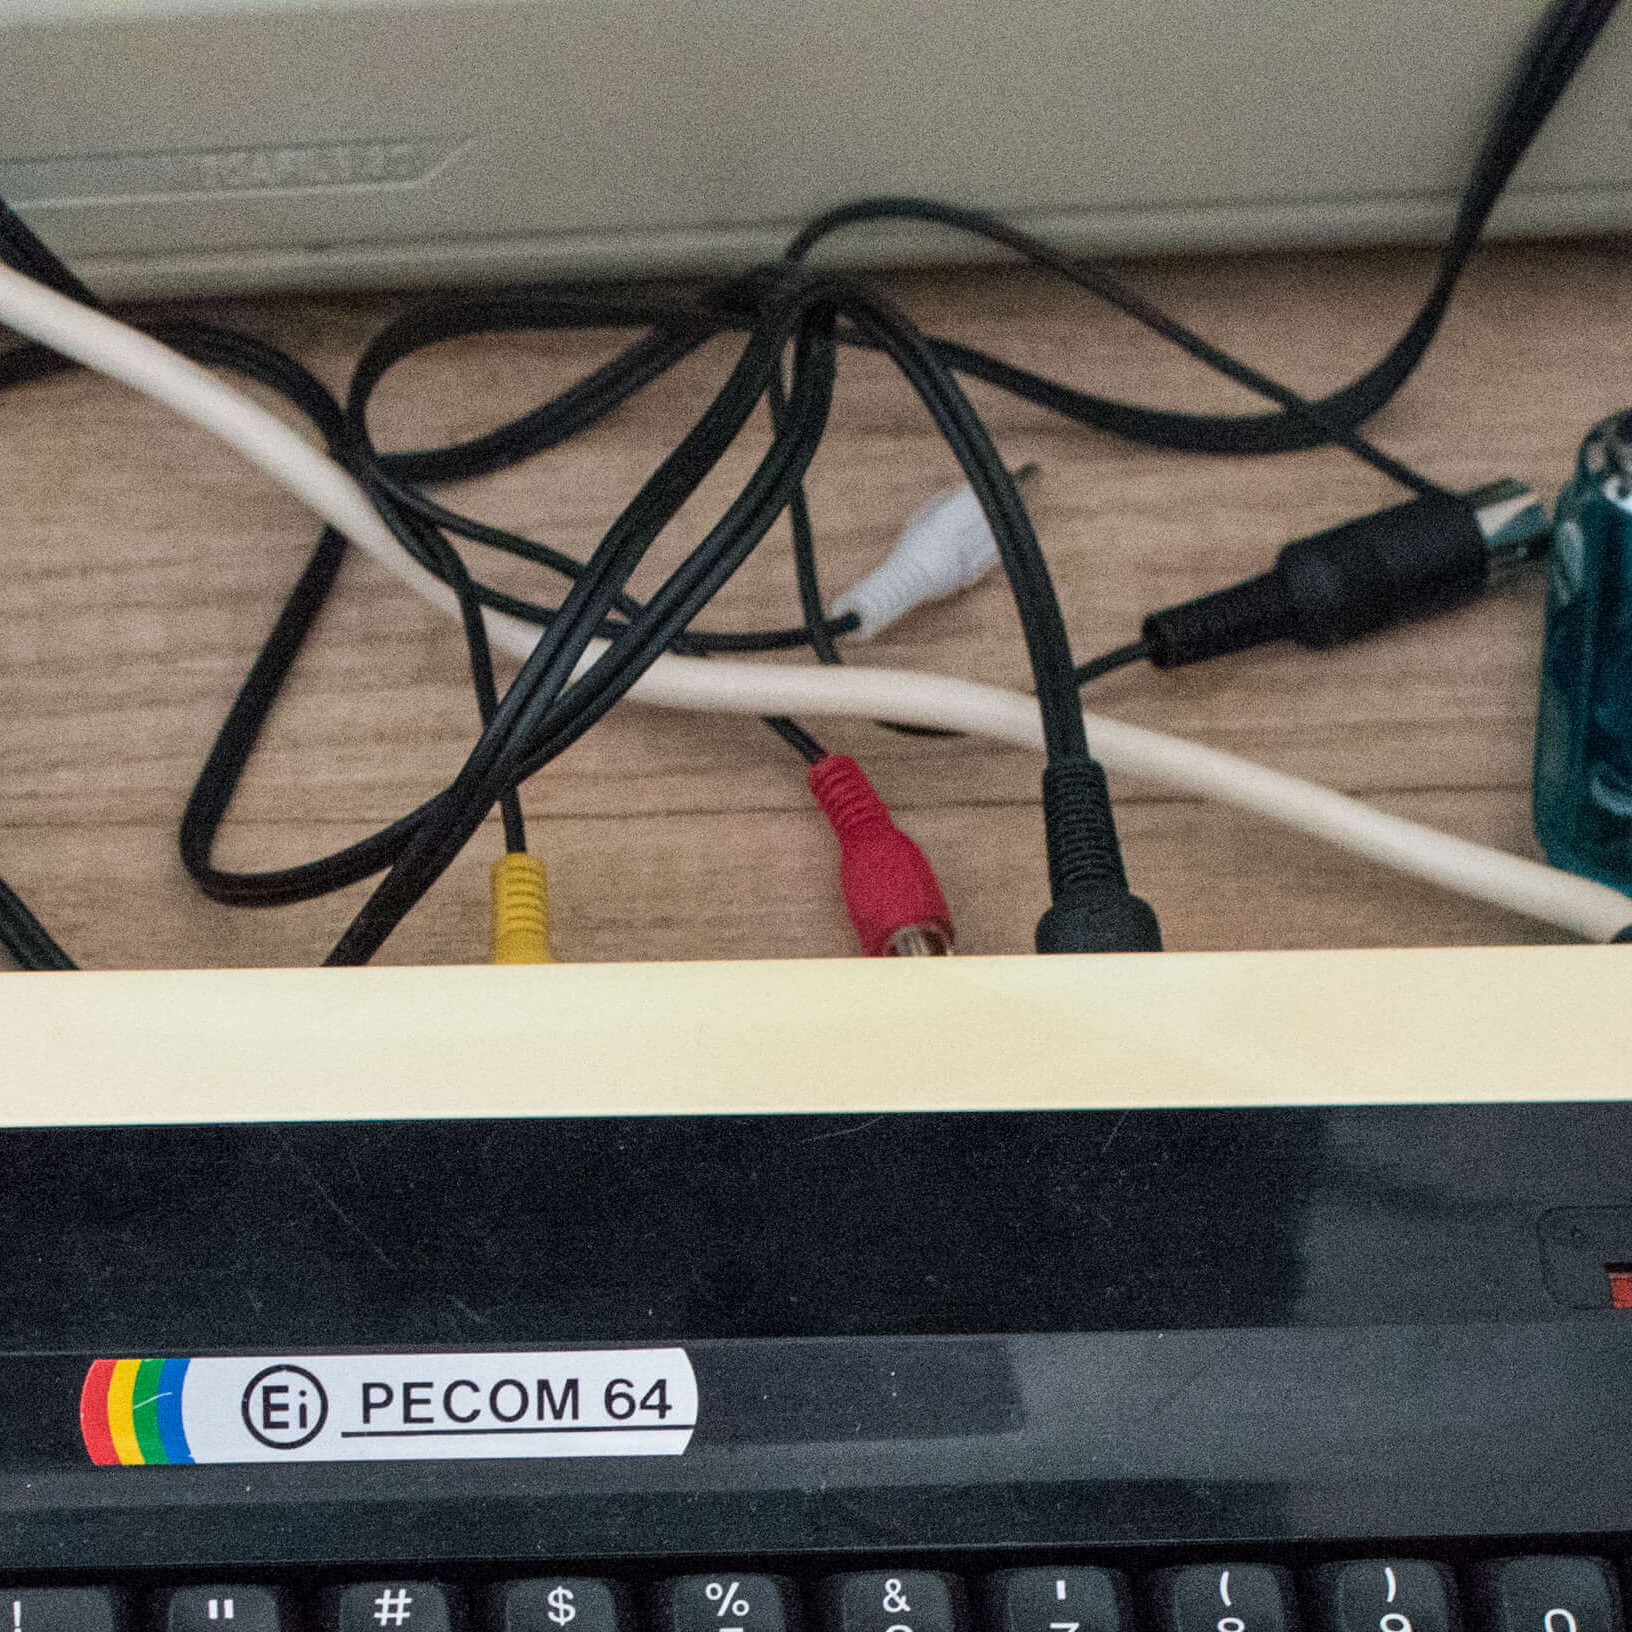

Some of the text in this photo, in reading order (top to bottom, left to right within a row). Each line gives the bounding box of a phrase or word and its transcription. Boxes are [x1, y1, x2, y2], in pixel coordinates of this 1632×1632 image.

[260, 1377, 673, 1432] Ei PECOM 64
[373, 1588, 413, 1626] #
[547, 1585, 576, 1626] $
[705, 1581, 750, 1617] %
[882, 1578, 911, 1613] &
